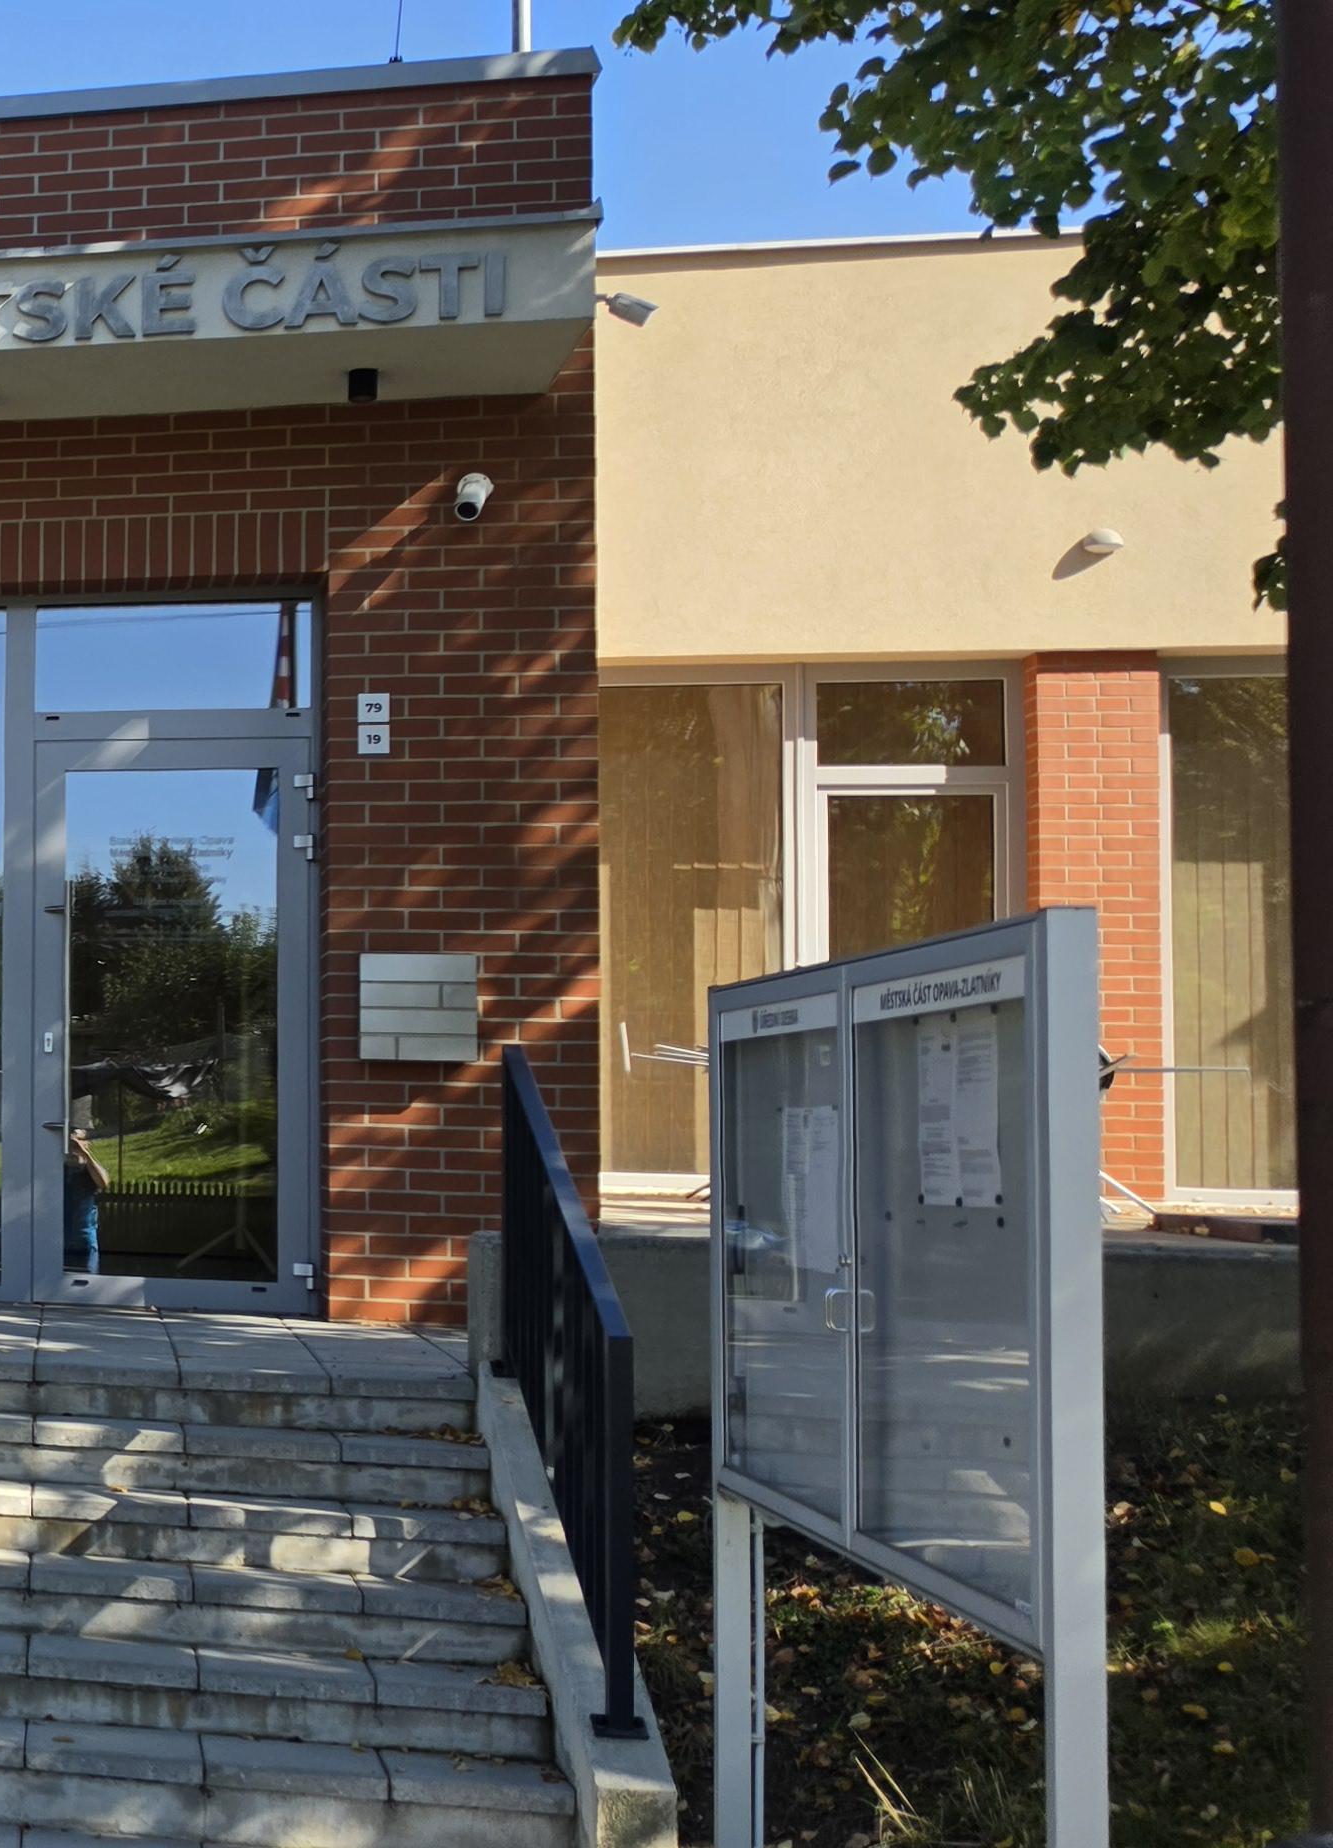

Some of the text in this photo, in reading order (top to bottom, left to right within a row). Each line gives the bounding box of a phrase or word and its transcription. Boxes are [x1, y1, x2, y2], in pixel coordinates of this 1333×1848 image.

[222, 242, 509, 332] ČÁSTI
[365, 702, 383, 713] 79
[366, 734, 382, 745] 19
[879, 967, 1002, 1011] MĚSTSKÁ ČÁST OPAVA-ZLATNÍKY
